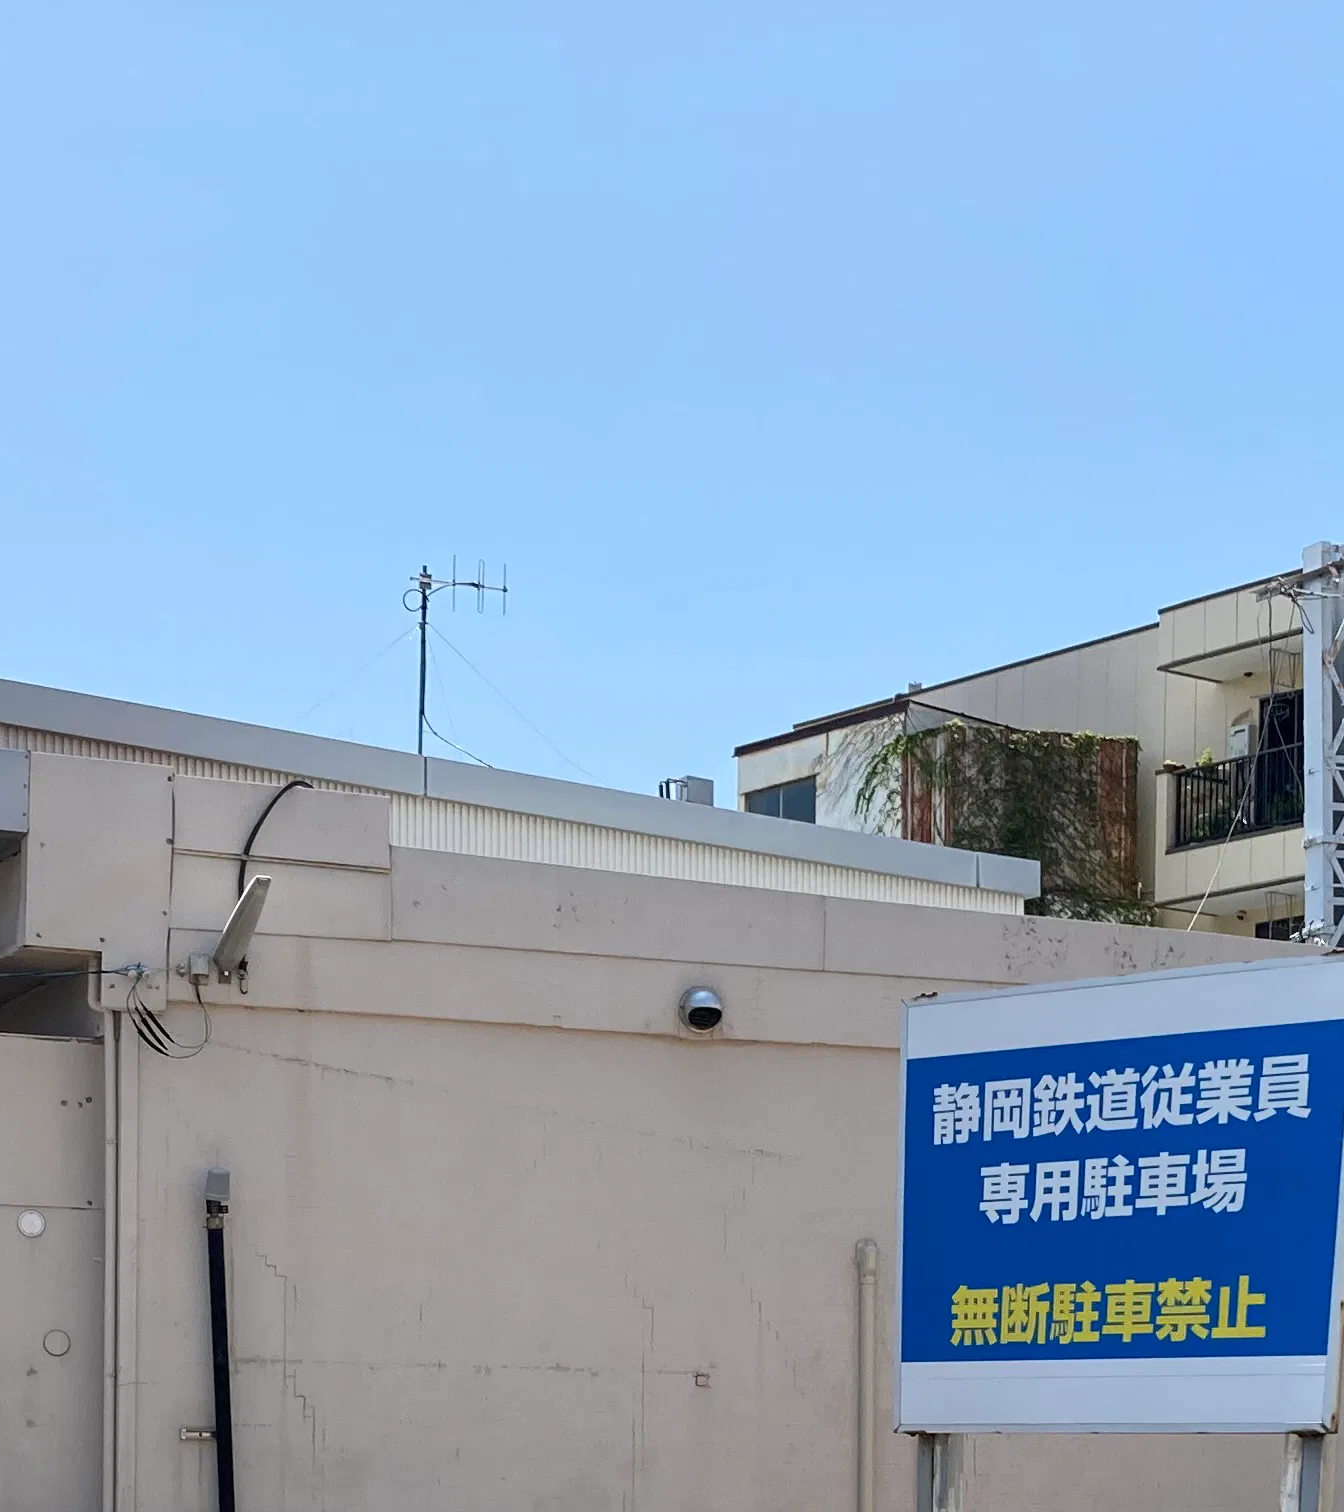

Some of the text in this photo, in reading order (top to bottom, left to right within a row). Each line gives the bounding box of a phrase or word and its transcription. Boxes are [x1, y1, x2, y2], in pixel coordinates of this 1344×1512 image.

[933, 1054, 1311, 1145] 静岡鉄道従業員
[980, 1148, 1247, 1224] 専用駐車場
[950, 1275, 1266, 1346] 無断駐車禁止
